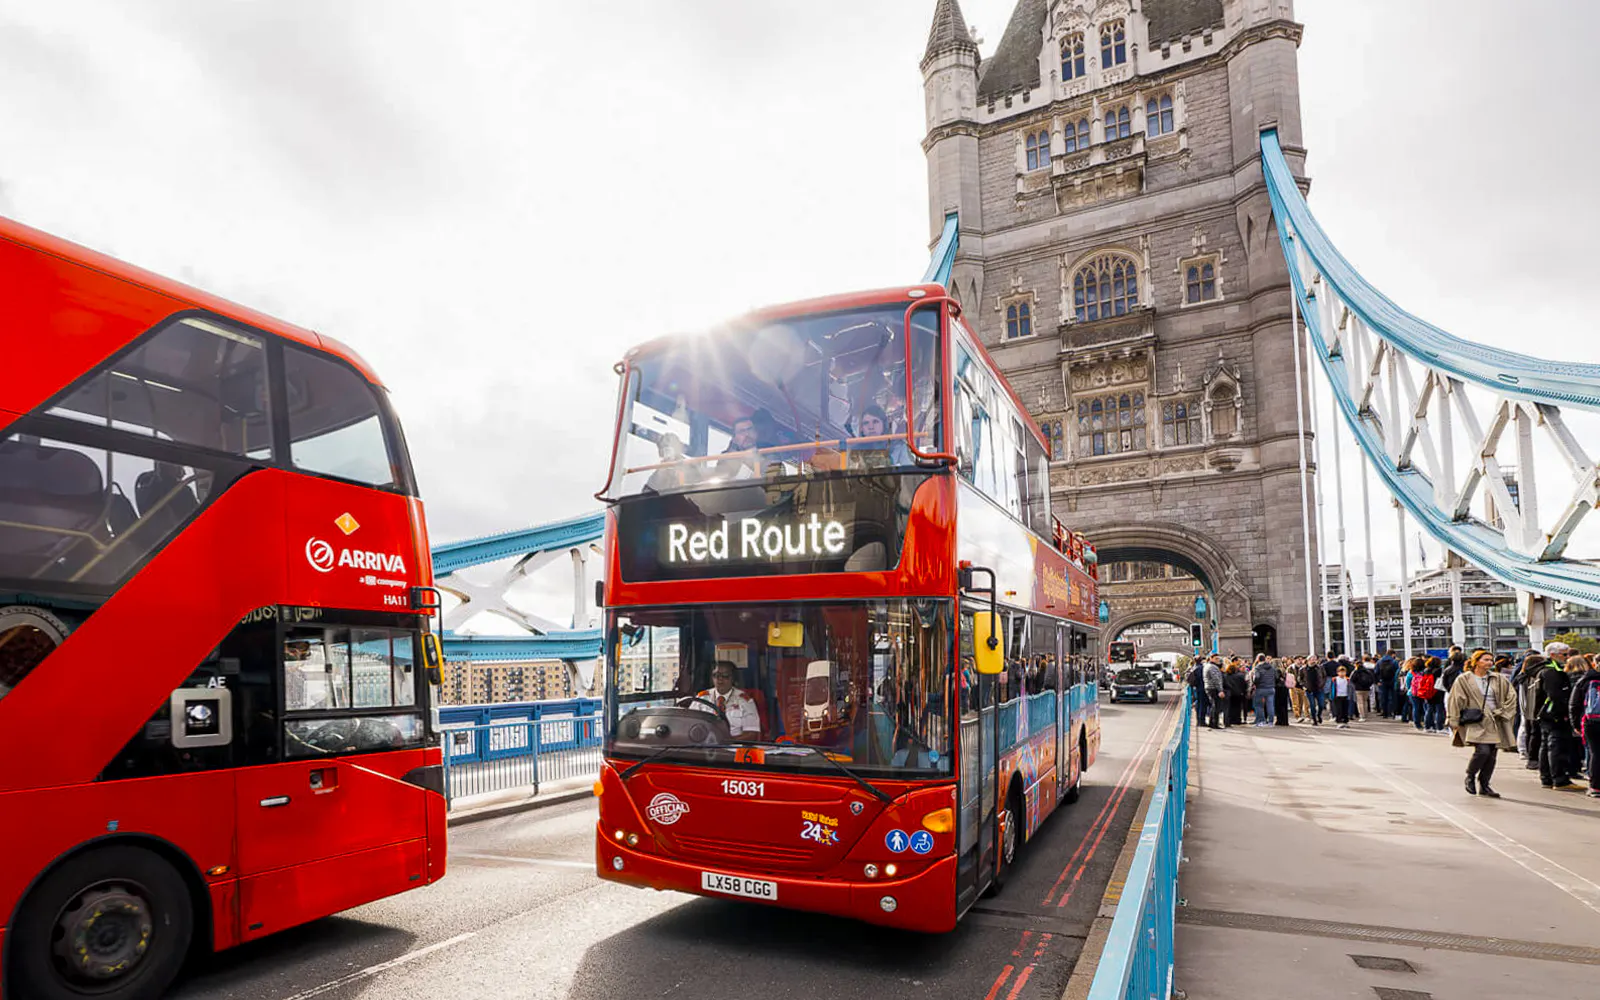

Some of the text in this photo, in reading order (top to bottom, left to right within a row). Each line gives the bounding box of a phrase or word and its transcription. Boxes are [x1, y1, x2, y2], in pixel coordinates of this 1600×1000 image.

[668, 512, 846, 563] Red Route
[338, 548, 407, 574] ARRIVA
[383, 594, 408, 606] HA11
[1418, 615, 1453, 625] Inside
[208, 676, 227, 689] AE
[720, 779, 765, 797] 15031
[649, 803, 686, 818] OFFICIAL
[800, 820, 821, 842] 24
[707, 874, 771, 897] LX58 CGG
